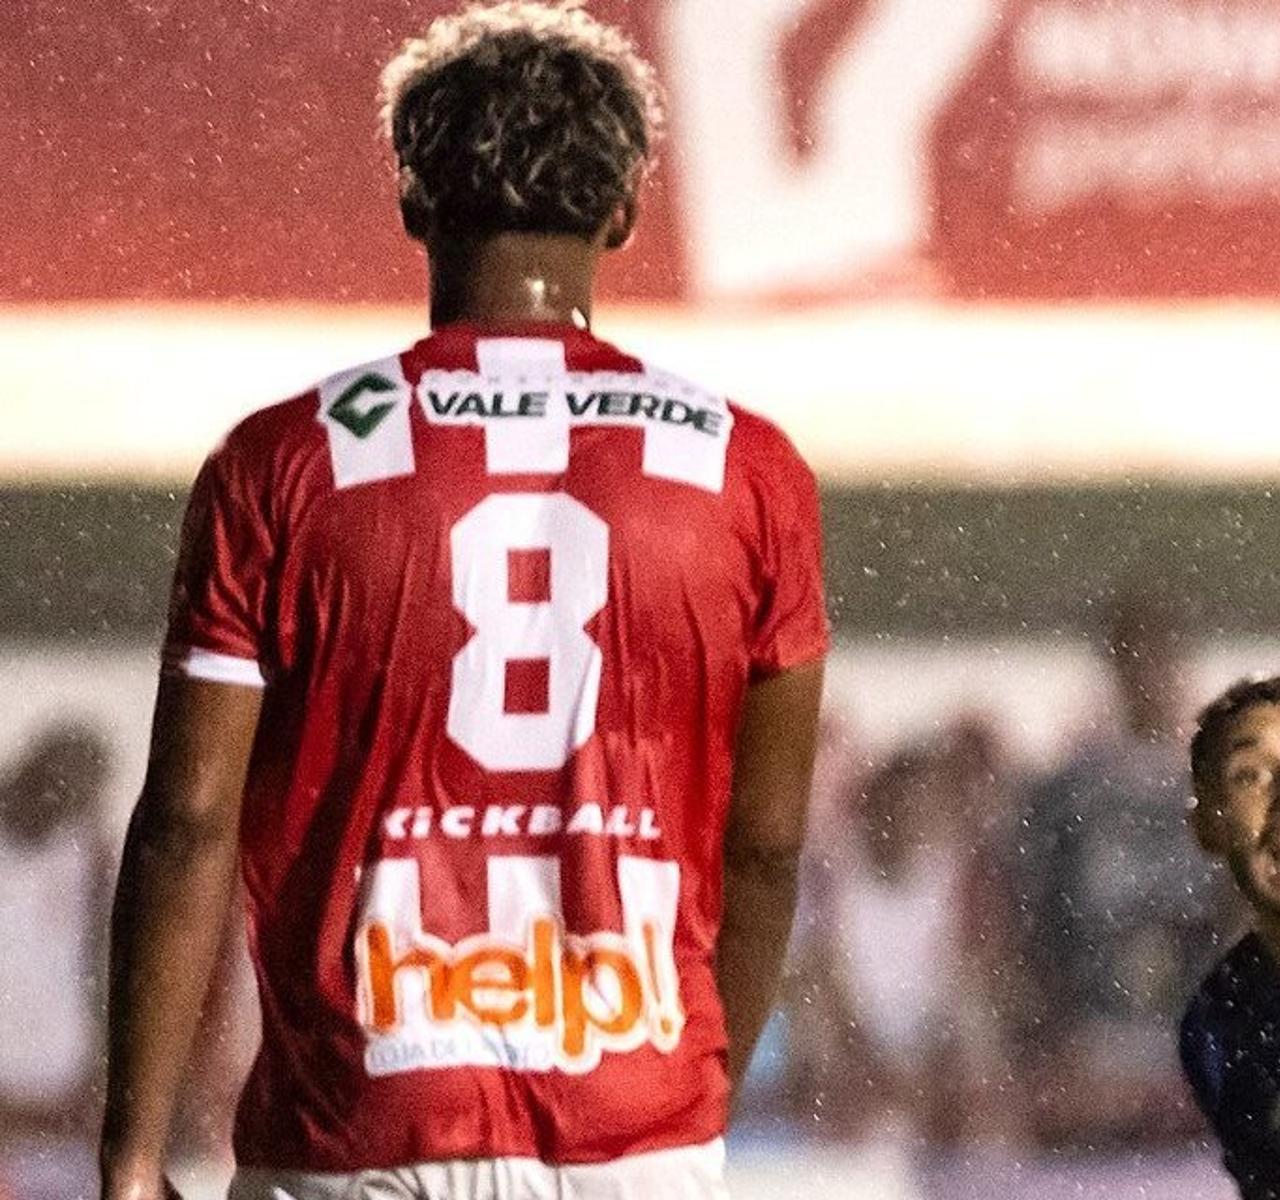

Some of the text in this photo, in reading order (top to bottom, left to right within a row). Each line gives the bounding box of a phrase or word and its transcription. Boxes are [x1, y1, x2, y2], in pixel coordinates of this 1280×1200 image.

[427, 391, 724, 436] VALE VERDE
[446, 493, 610, 771] 8
[383, 803, 662, 841] KICKBALL
[367, 919, 674, 1058] help!
